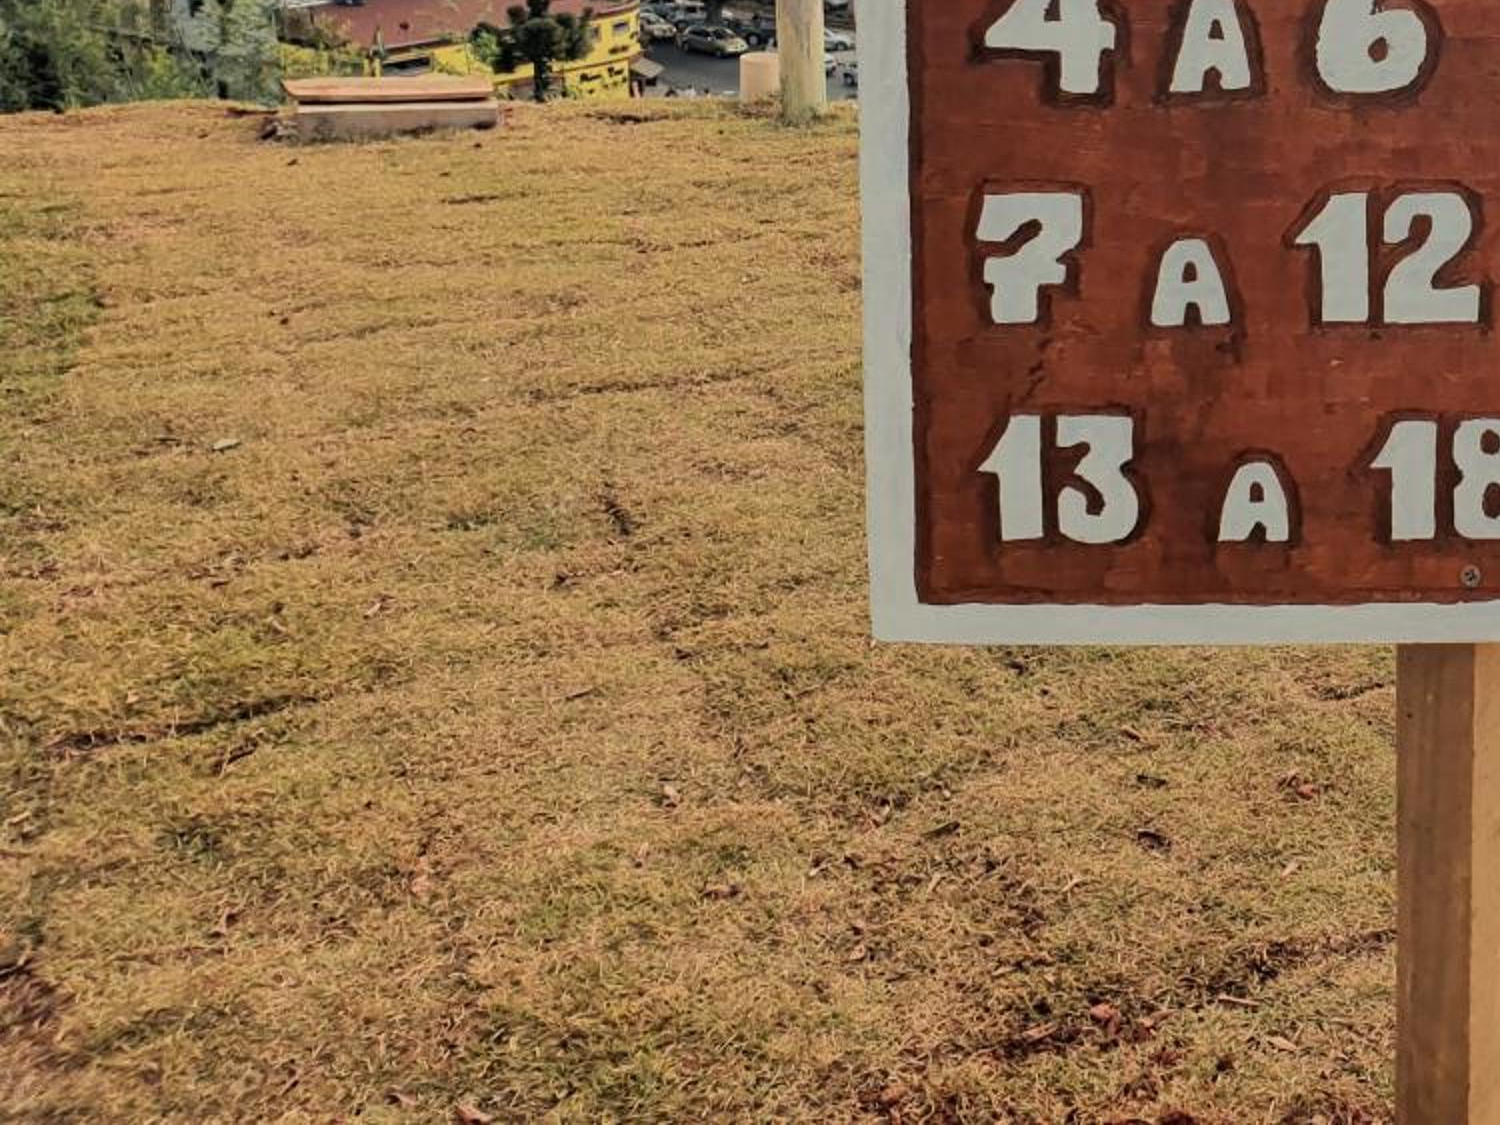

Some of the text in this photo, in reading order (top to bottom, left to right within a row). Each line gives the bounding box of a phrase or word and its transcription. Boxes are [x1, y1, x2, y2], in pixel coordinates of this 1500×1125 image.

[976, 193, 1480, 326] 7 A 12
[978, 415, 1138, 543] 13
[1218, 462, 1289, 542] A
